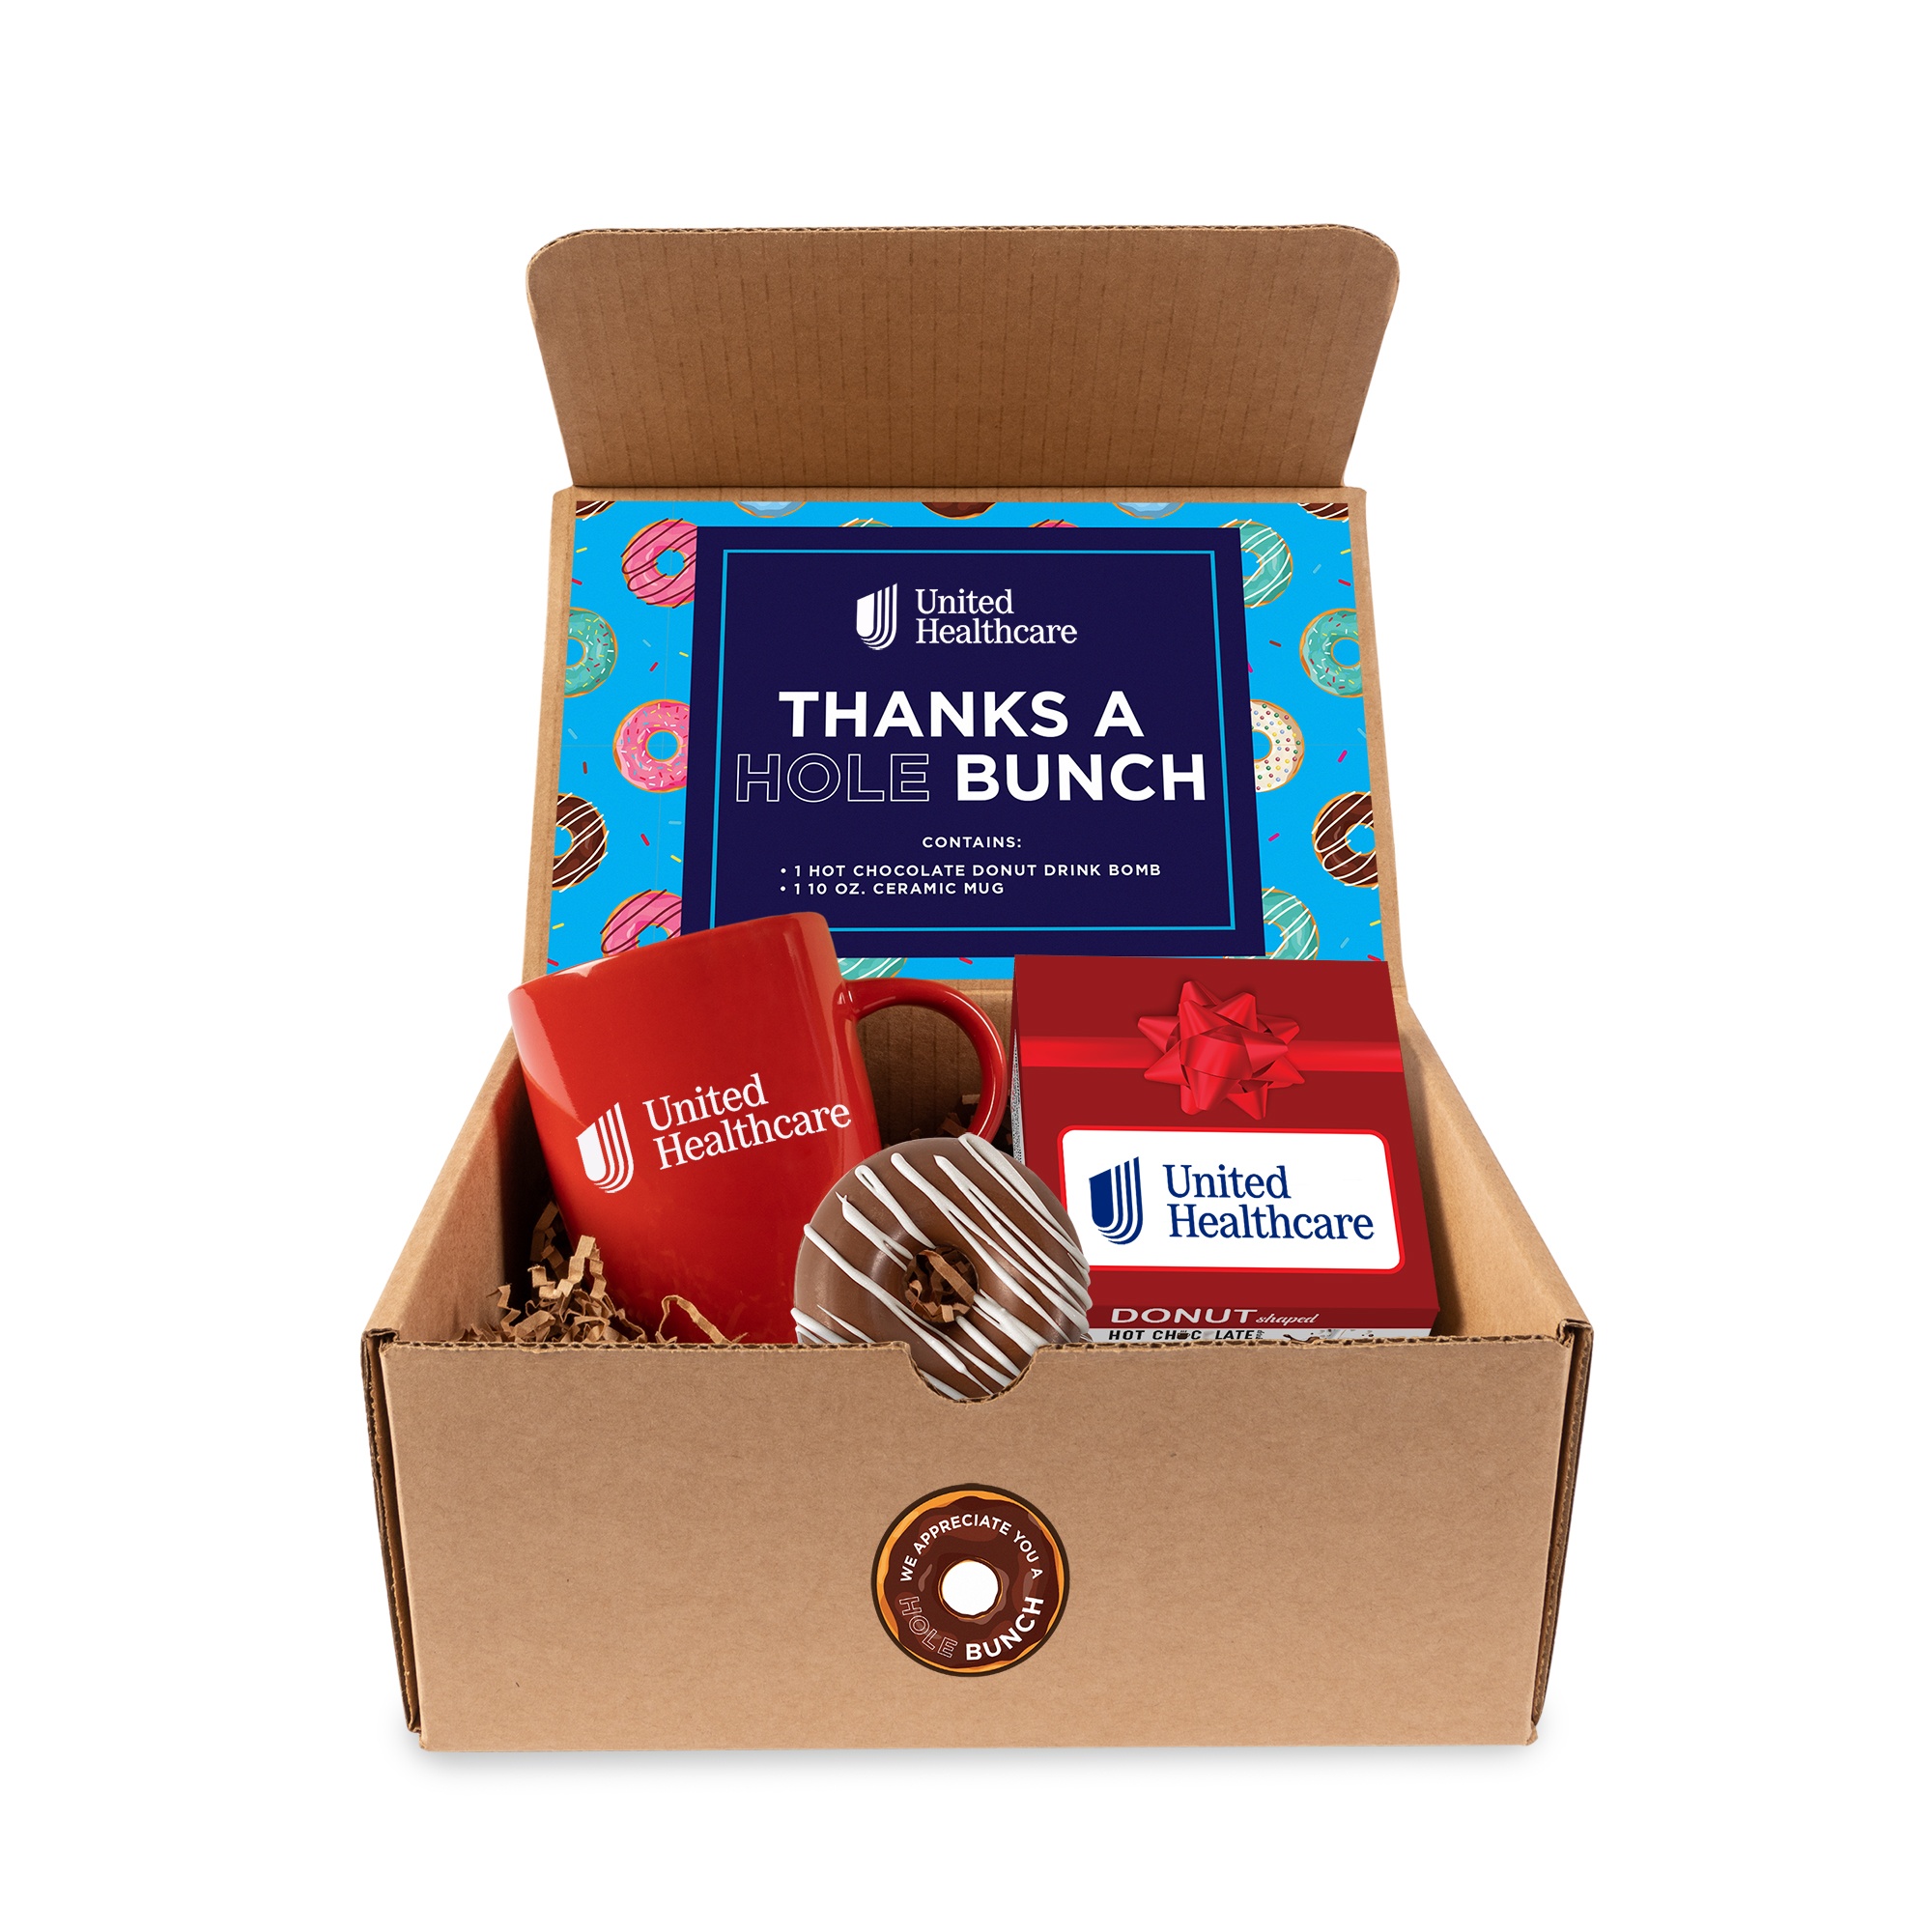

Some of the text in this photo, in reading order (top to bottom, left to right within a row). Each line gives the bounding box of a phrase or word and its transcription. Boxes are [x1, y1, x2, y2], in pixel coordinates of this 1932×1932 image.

[915, 587, 1015, 614] United
[915, 617, 1078, 644] Healthcare
[778, 690, 1145, 738] THANKS A
[735, 753, 1206, 804] HOLE BUNCH
[922, 836, 1022, 848] CONTAINS:
[794, 864, 1161, 877] 1 HOT CHOCOLATE DONUT DRINK BOMB
[794, 882, 1004, 895] 1 10 OZ. CERAMIC MUG
[641, 1072, 769, 1132] United
[652, 1102, 852, 1171] Healthcare
[1162, 1163, 1293, 1200] United
[1166, 1203, 1376, 1240] Healthcare
[1108, 1329, 1146, 1341] HOT
[1151, 1329, 1255, 1341] CHCLATE
[1111, 1307, 1320, 1326] DONUT shaped
[899, 1514, 1043, 1582] WE APPRECIATE YOU A
[898, 1596, 1044, 1661] HOLE BUNCH
